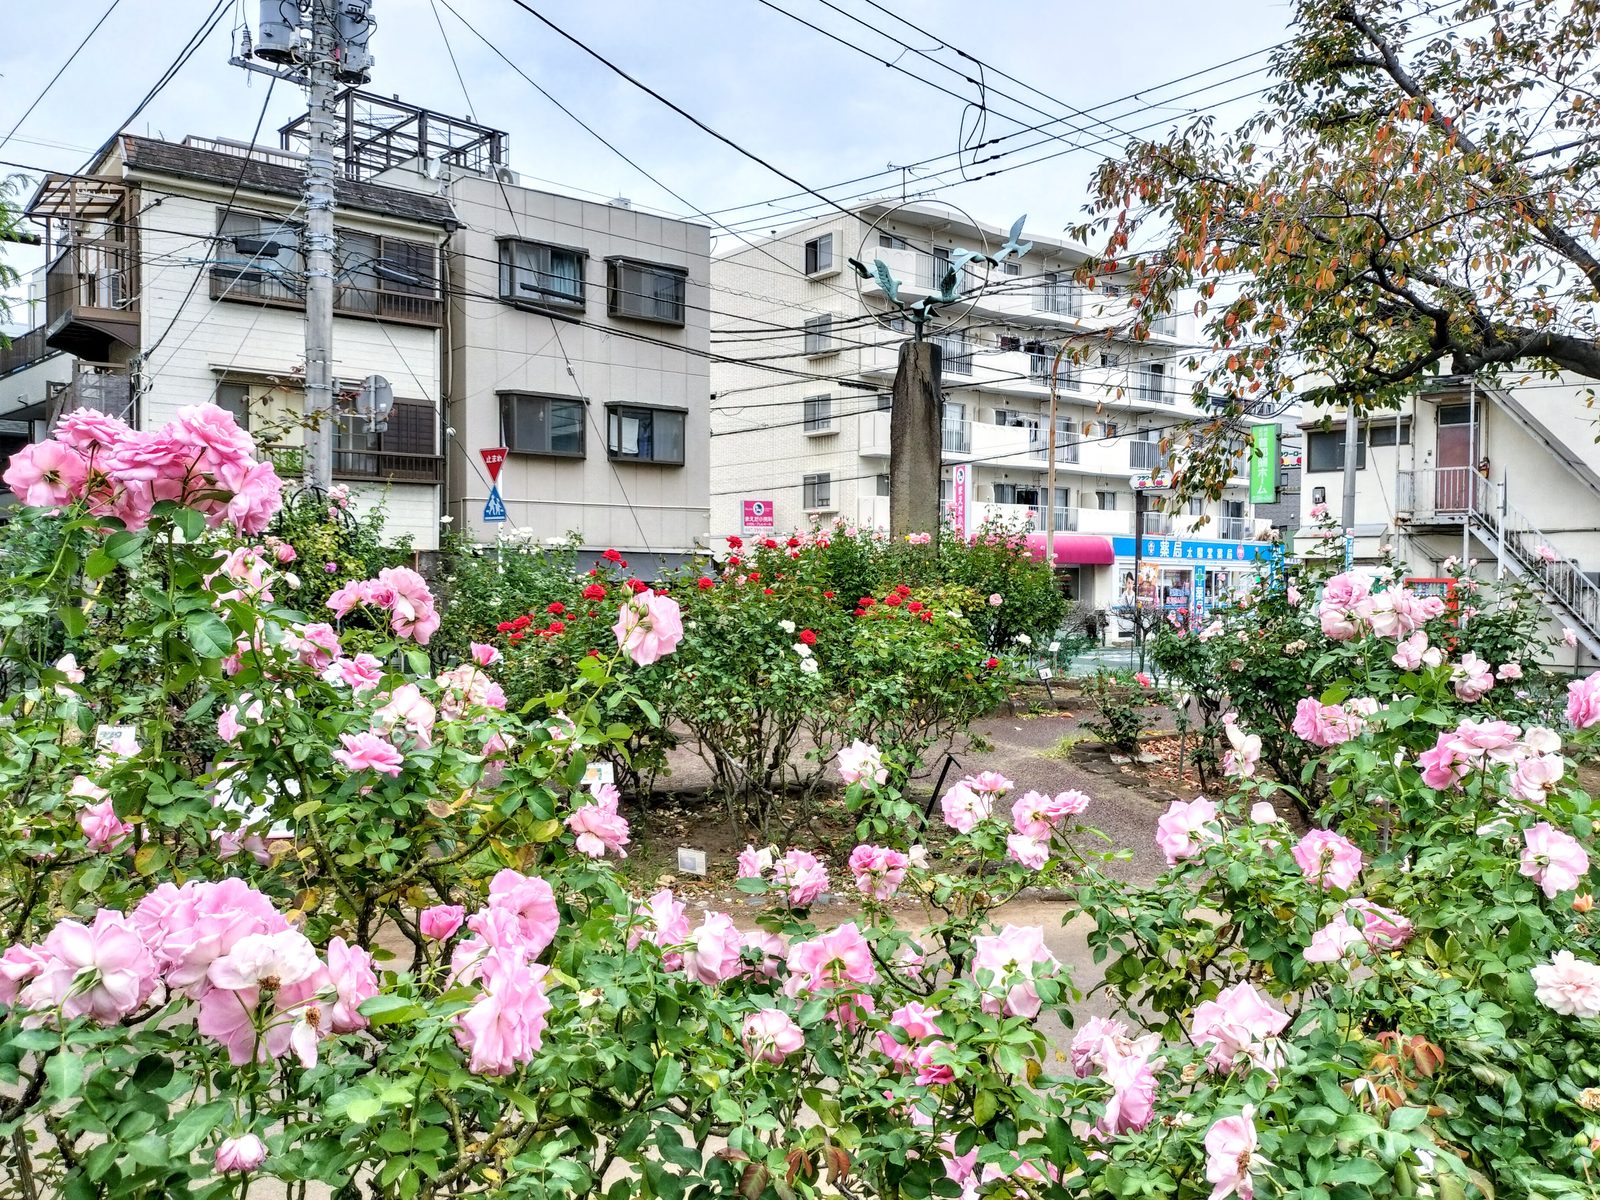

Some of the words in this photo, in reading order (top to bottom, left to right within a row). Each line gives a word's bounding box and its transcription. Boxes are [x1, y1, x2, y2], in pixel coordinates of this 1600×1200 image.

[486, 455, 503, 464] 止まれ
[1159, 541, 1183, 558] 薬局
